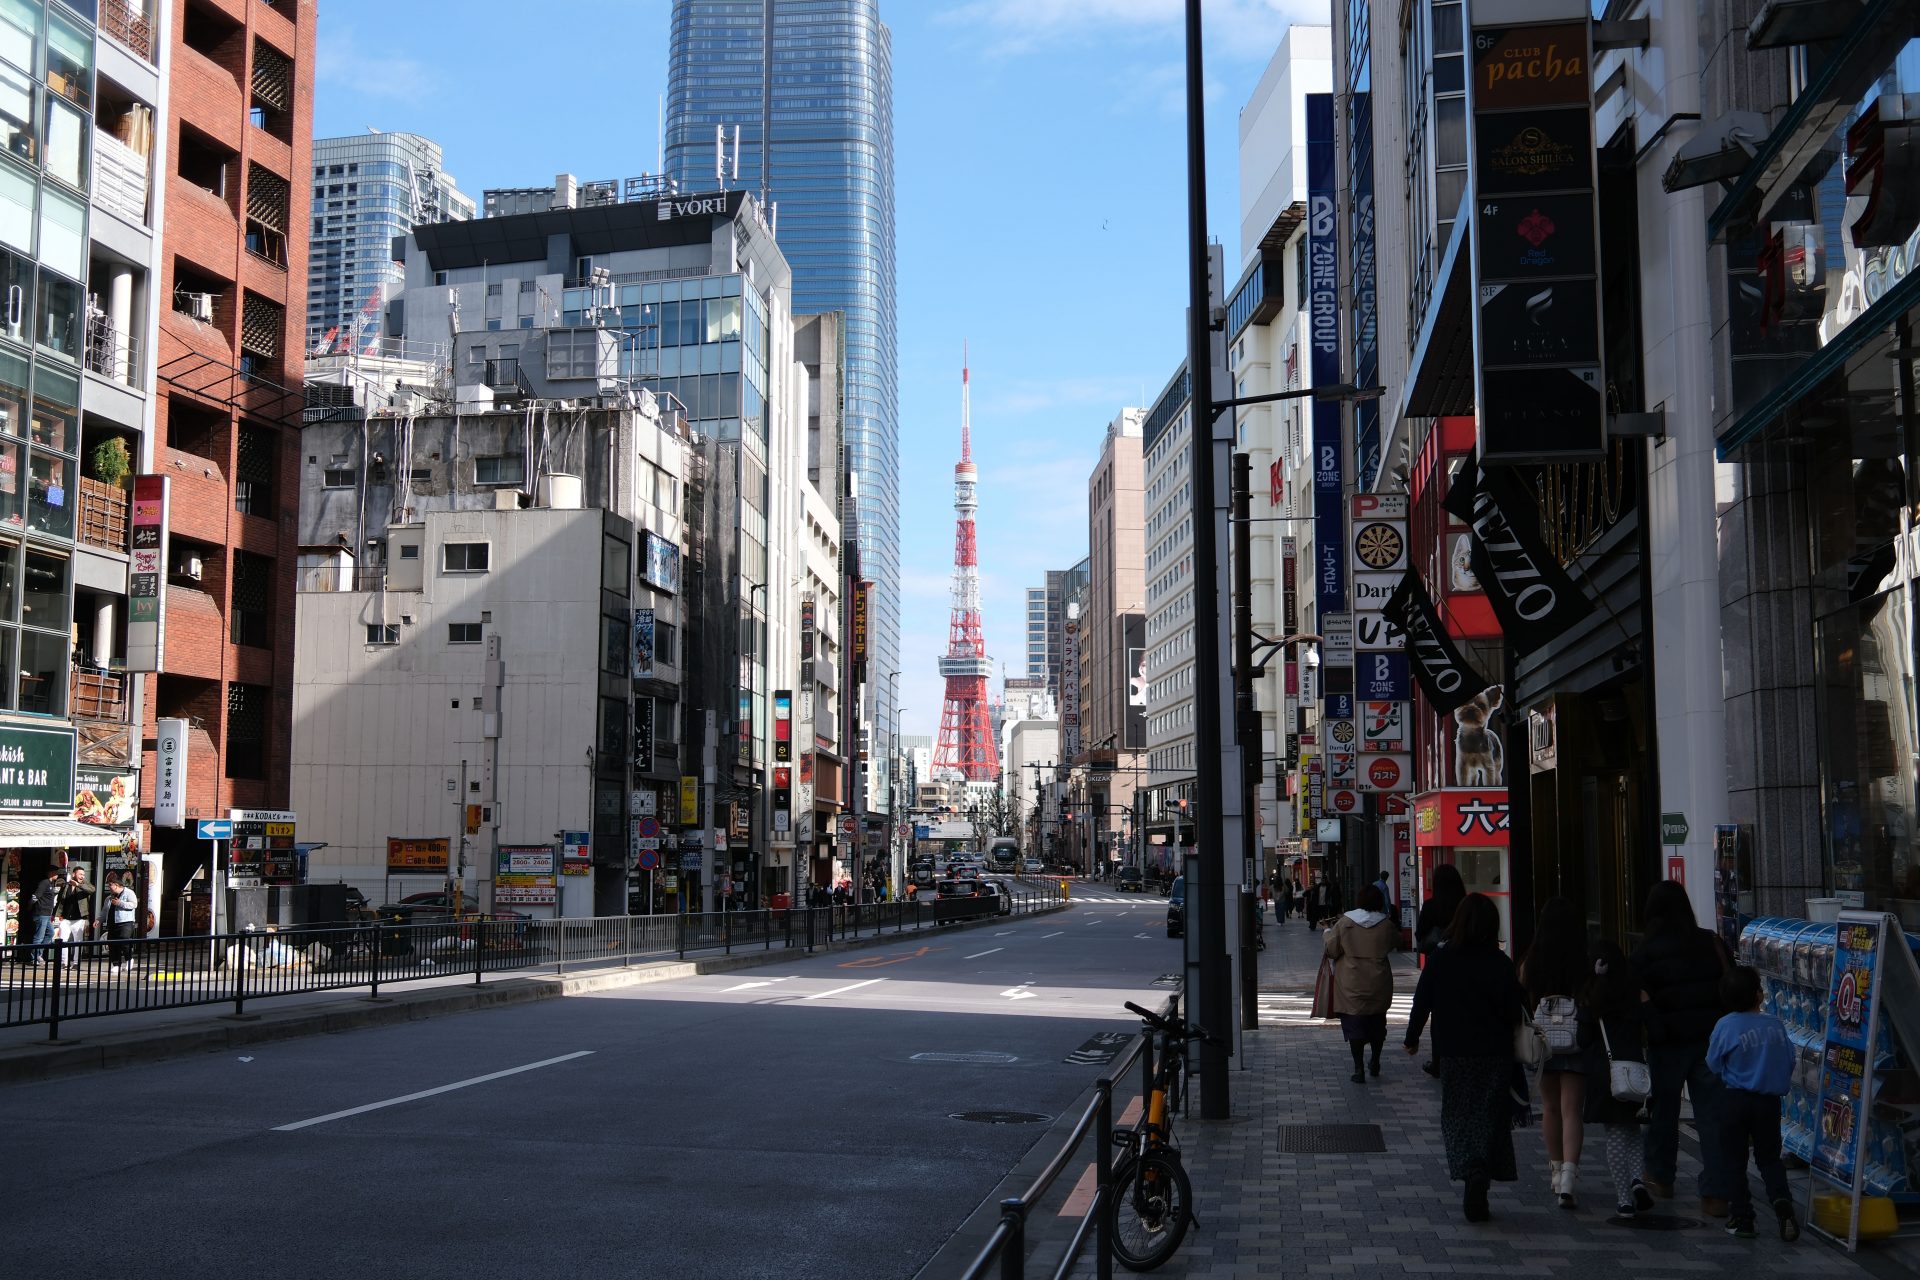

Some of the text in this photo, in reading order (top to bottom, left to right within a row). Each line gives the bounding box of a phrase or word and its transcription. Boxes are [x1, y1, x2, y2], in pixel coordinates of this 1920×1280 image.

[1476, 34, 1495, 49] 6F
[1503, 47, 1541, 58] CLUB
[1486, 44, 1582, 90] pacha
[1491, 153, 1575, 167] SALON SHILICA
[675, 197, 725, 216] VORT
[1482, 204, 1499, 216] 4F
[1527, 249, 1546, 257] Red
[1520, 256, 1554, 266] Dragon
[1482, 285, 1497, 297] 3F
[1321, 446, 1335, 470] B
[1316, 471, 1340, 482] ZONE
[1353, 495, 1379, 517] P
[1355, 582, 1399, 599] Dart
[1397, 640, 1405, 648] 2
[1065, 637, 1073, 677] カラオケ
[1375, 655, 1390, 680] B
[1369, 681, 1395, 693] ZONE
[1065, 683, 1073, 712] パセラ
[1390, 741, 1402, 749] ATM
[0, 744, 25, 763] kish
[17, 769, 25, 785] &
[28, 770, 47, 786] BAR
[1373, 771, 1397, 780] ガスト
[270, 826, 290, 834] ミリオン
[1398, 829, 1410, 839] ガ
